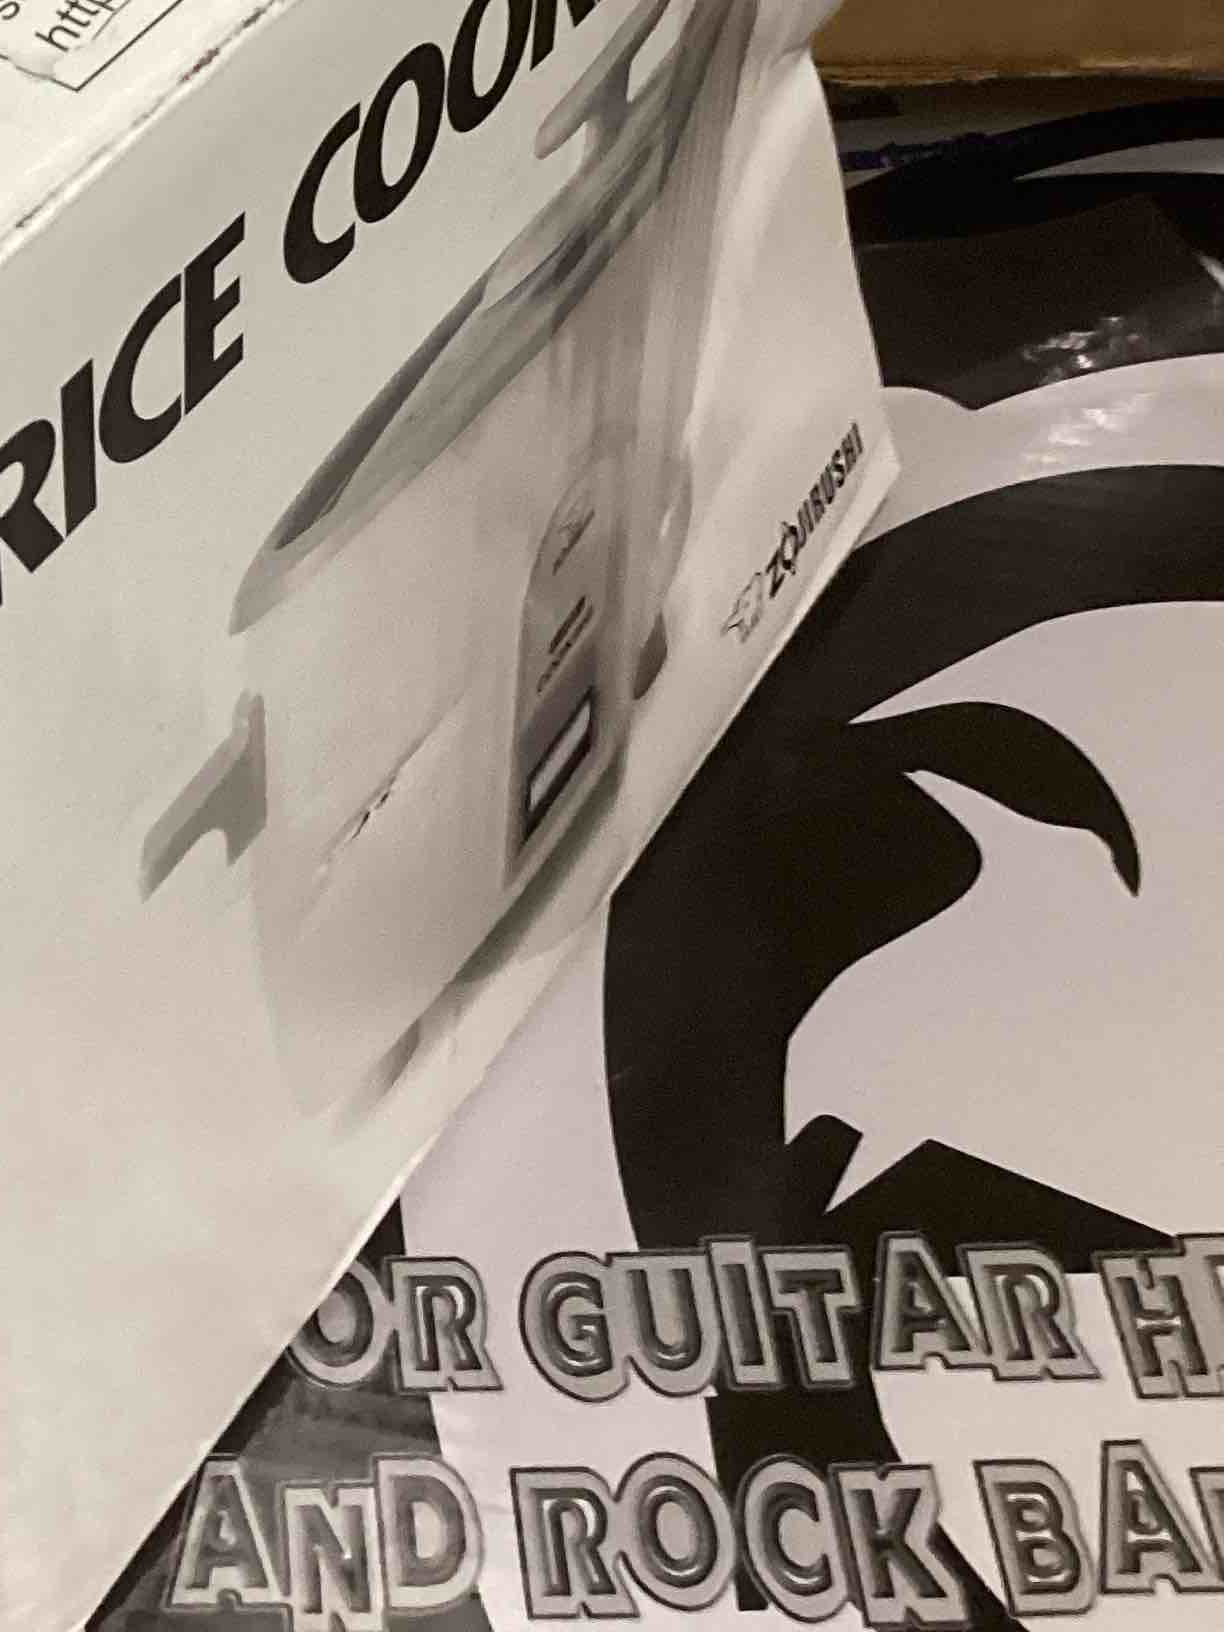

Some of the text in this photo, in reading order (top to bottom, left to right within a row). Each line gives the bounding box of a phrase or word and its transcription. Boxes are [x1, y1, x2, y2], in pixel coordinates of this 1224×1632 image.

[519, 1231, 1102, 1402] GUITAR
[1090, 1233, 1224, 1399] H
[160, 1451, 486, 1632] AND
[509, 1451, 972, 1629] ROCK
